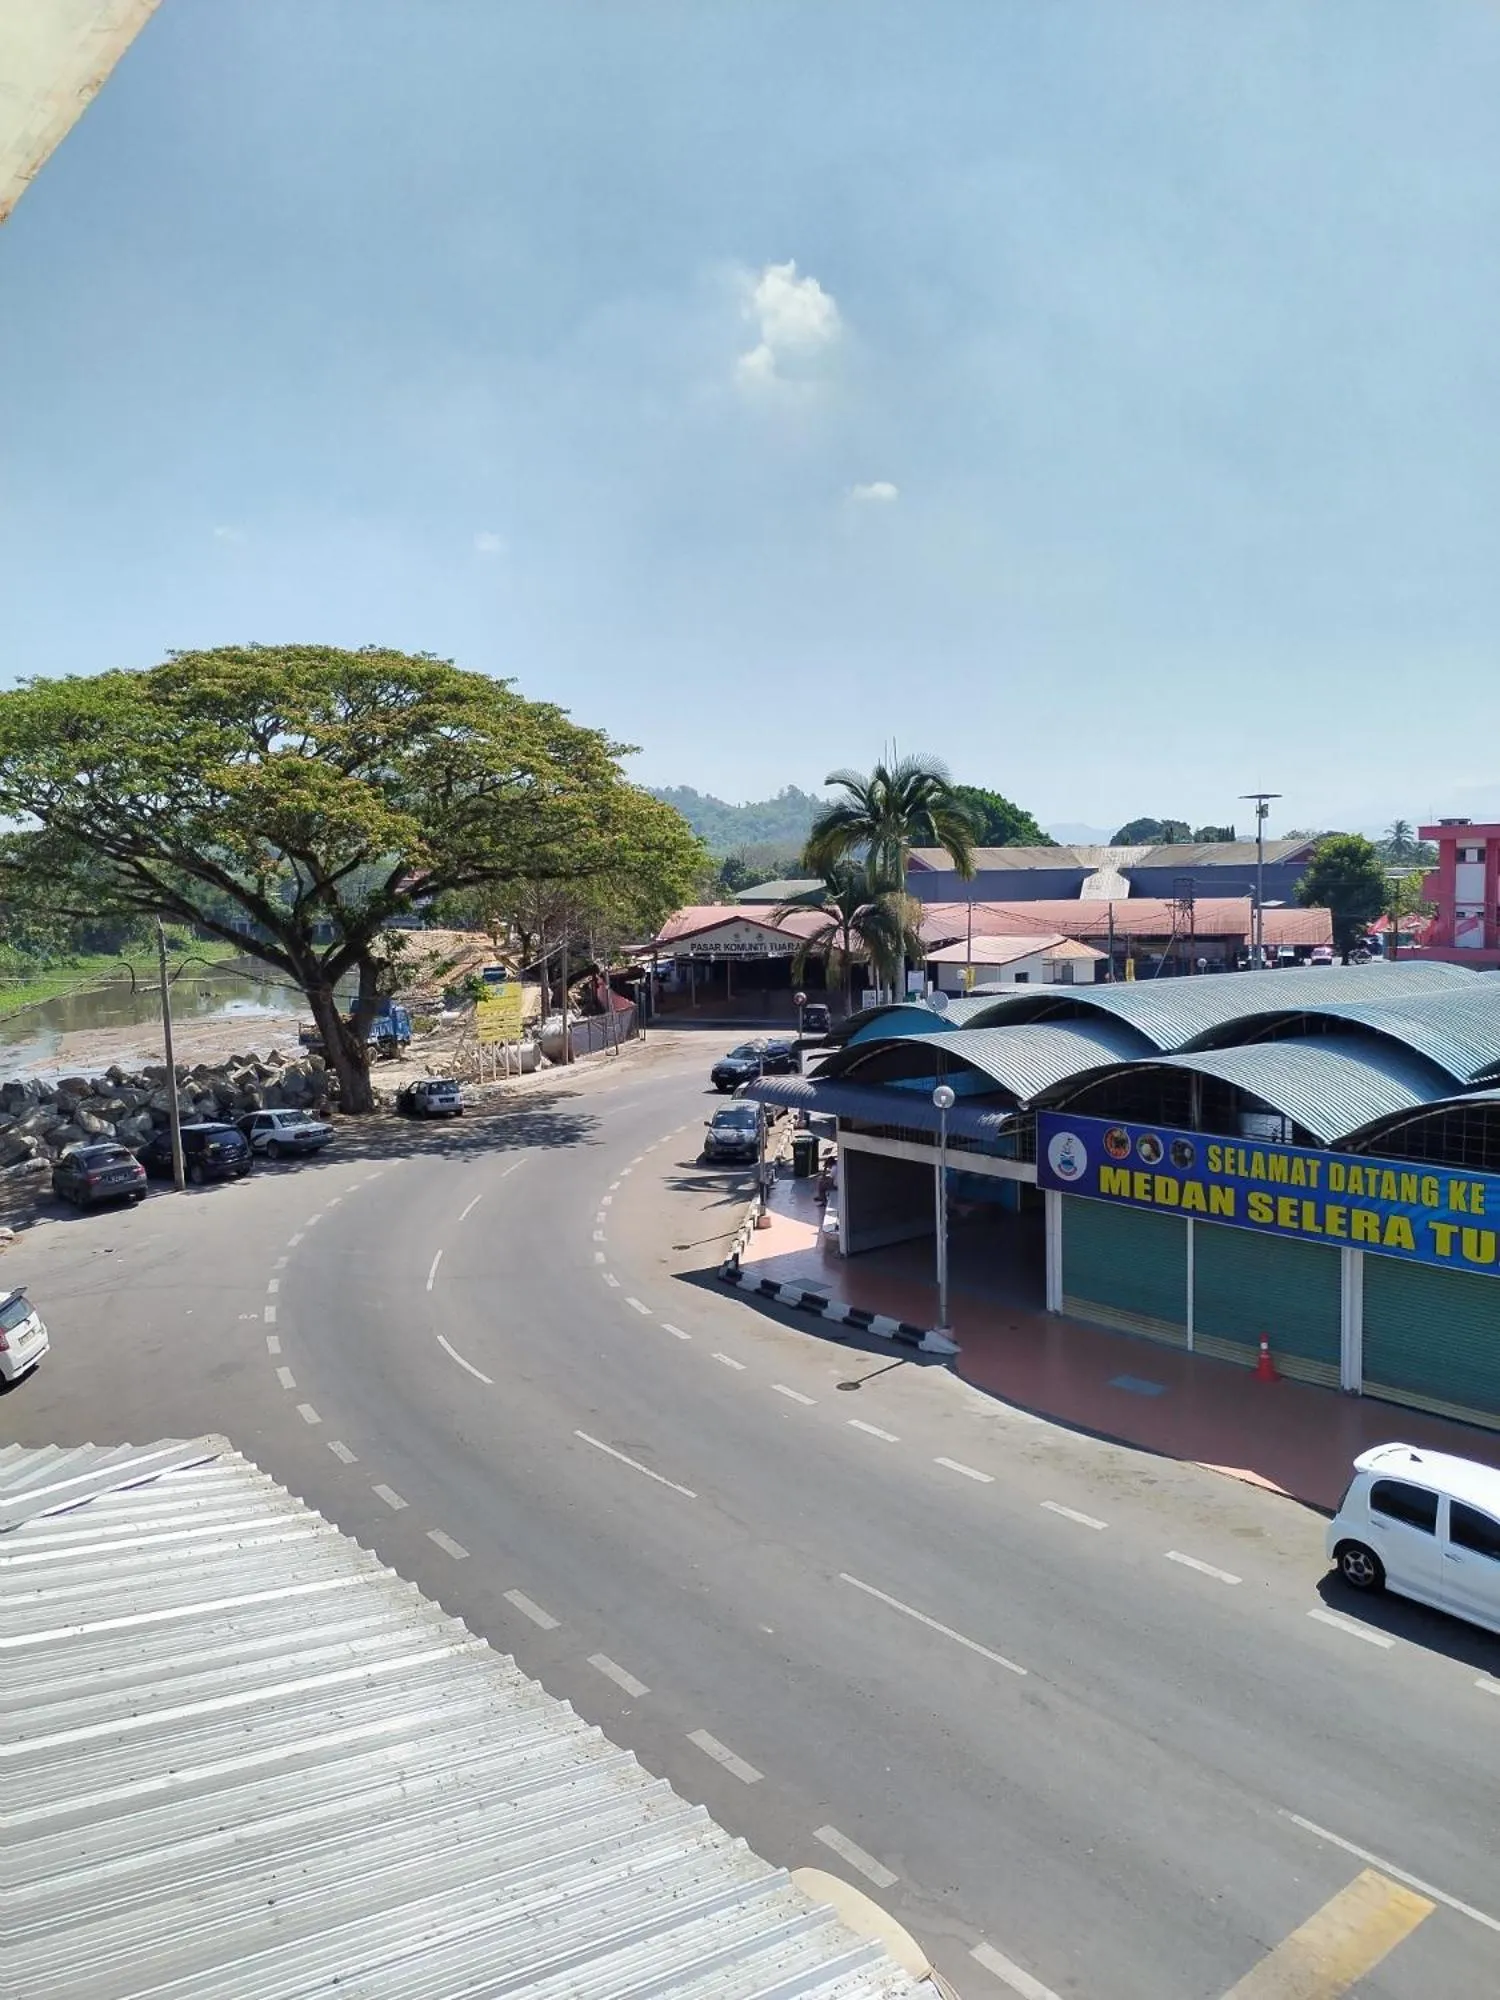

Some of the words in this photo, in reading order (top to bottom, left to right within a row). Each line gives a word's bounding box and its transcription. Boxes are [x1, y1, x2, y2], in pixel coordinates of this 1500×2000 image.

[690, 943, 721, 952] PASAR
[723, 943, 767, 952] KOMUNITI
[769, 943, 802, 952] TUARA
[1099, 1165, 1235, 1217] MEDAN
[1247, 1191, 1416, 1250] SELERA
[1429, 1221, 1499, 1265] TU
[1207, 1144, 1321, 1189] SELAMAT
[1328, 1162, 1440, 1208] DATANG
[1449, 1179, 1486, 1216] KE
